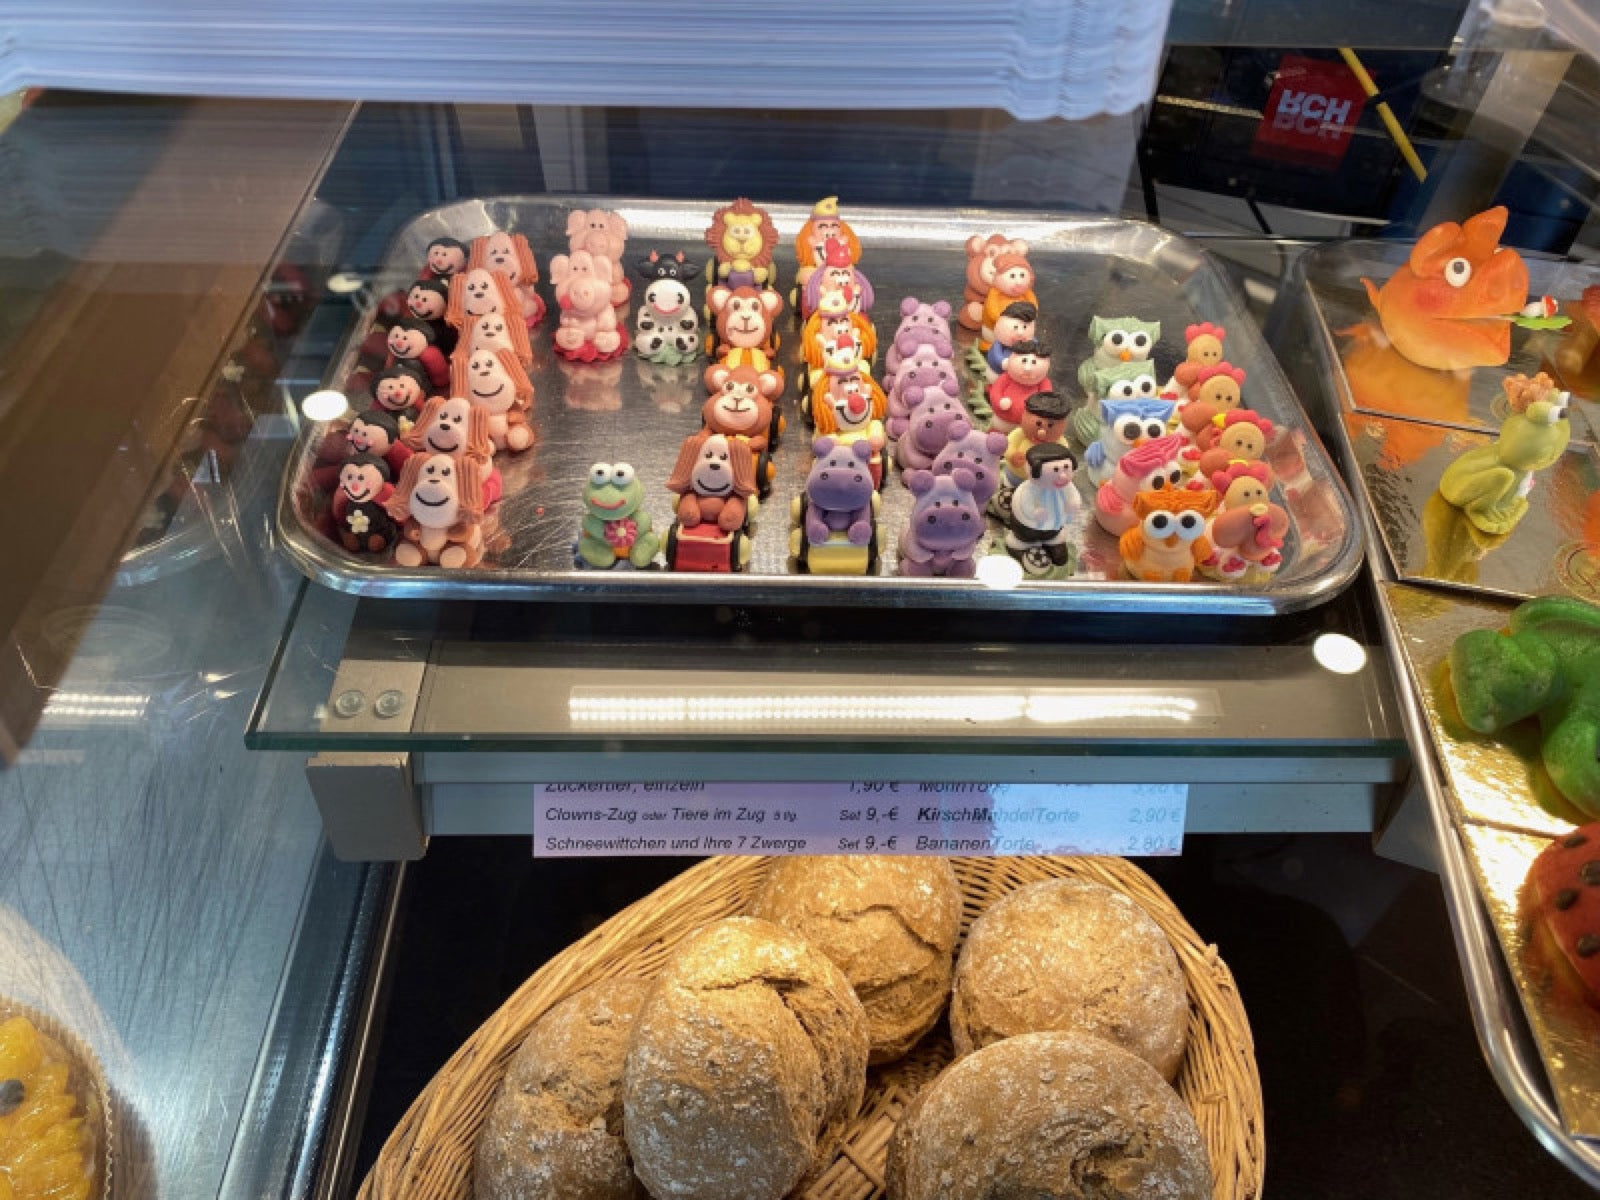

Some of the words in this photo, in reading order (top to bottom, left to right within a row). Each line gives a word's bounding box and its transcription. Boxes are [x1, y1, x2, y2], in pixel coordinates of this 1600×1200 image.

[545, 807, 637, 824] Clowns-Zug
[672, 807, 709, 821] Tiere
[713, 807, 731, 821] im
[735, 807, 766, 823] Zug
[839, 809, 861, 821] Set
[545, 836, 667, 850] Schneewittchen
[671, 836, 700, 849] und
[703, 836, 732, 849] Ihre
[737, 836, 747, 849] 7
[750, 836, 807, 852] Zwerge
[838, 837, 861, 850] Set
[916, 835, 1037, 850] BananenTorte
